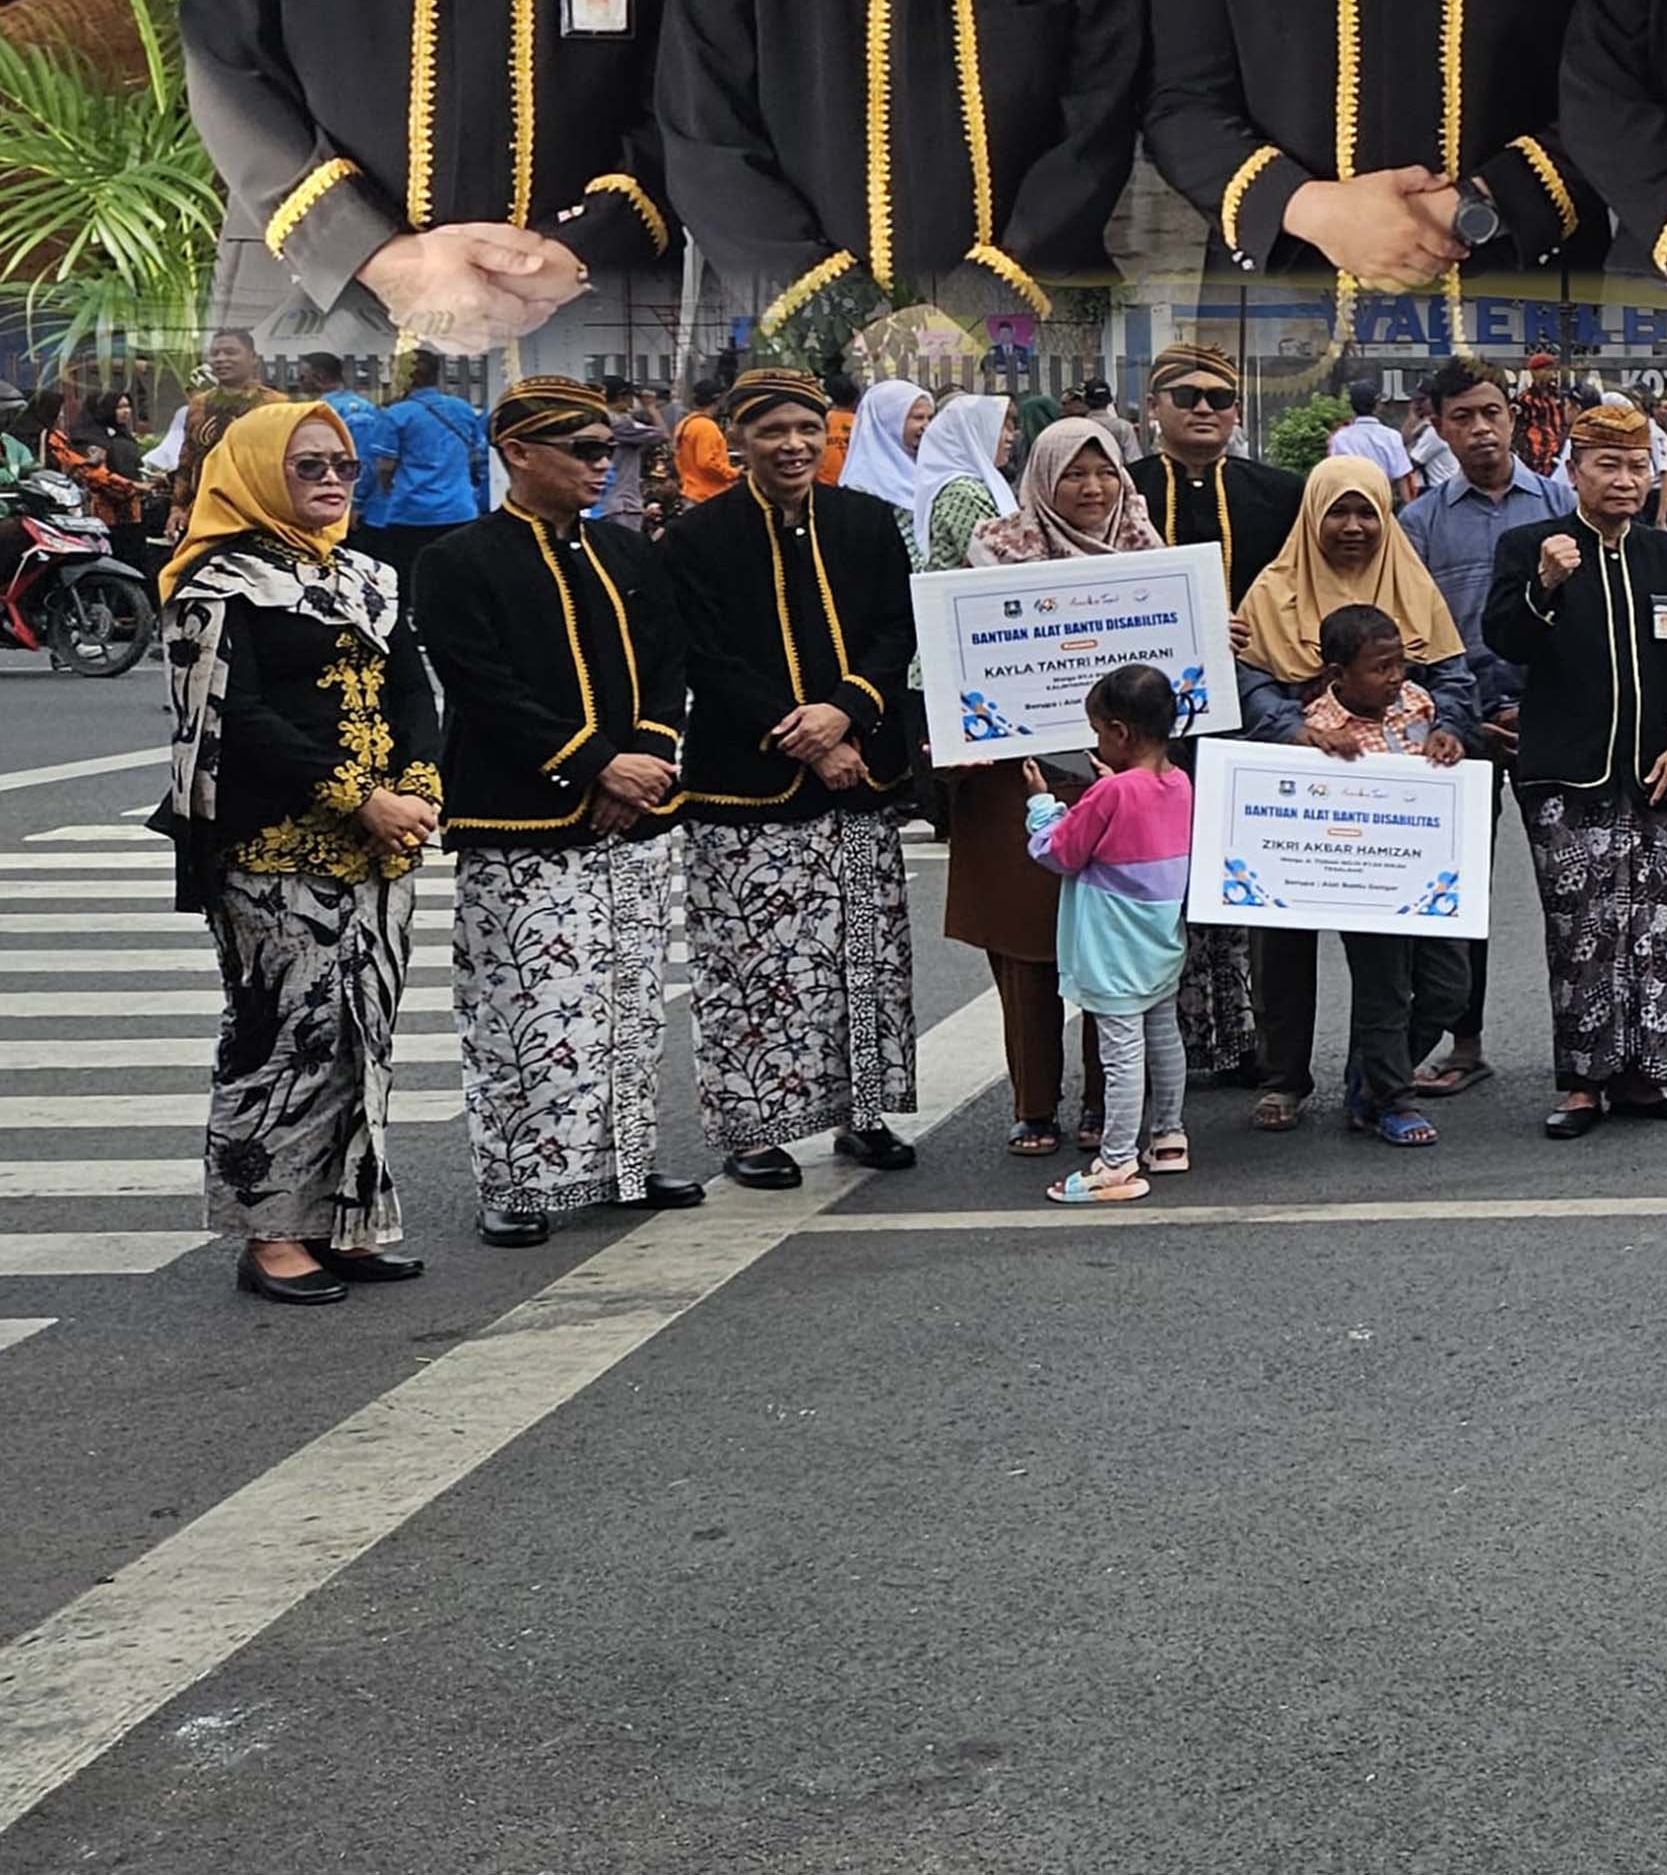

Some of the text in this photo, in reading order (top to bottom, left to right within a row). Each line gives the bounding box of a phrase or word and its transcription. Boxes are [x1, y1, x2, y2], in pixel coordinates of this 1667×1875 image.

[971, 611, 1179, 646] BANTUAN ALAT BANTU DISABILITAS
[984, 647, 1174, 679] KAYLA TANTRI MAHARANI
[1245, 804, 1441, 828] BANTUAN ALAT BANTU DISABILITAS
[1262, 838, 1422, 858] ZIKRI AKBAR HAMIZAN
